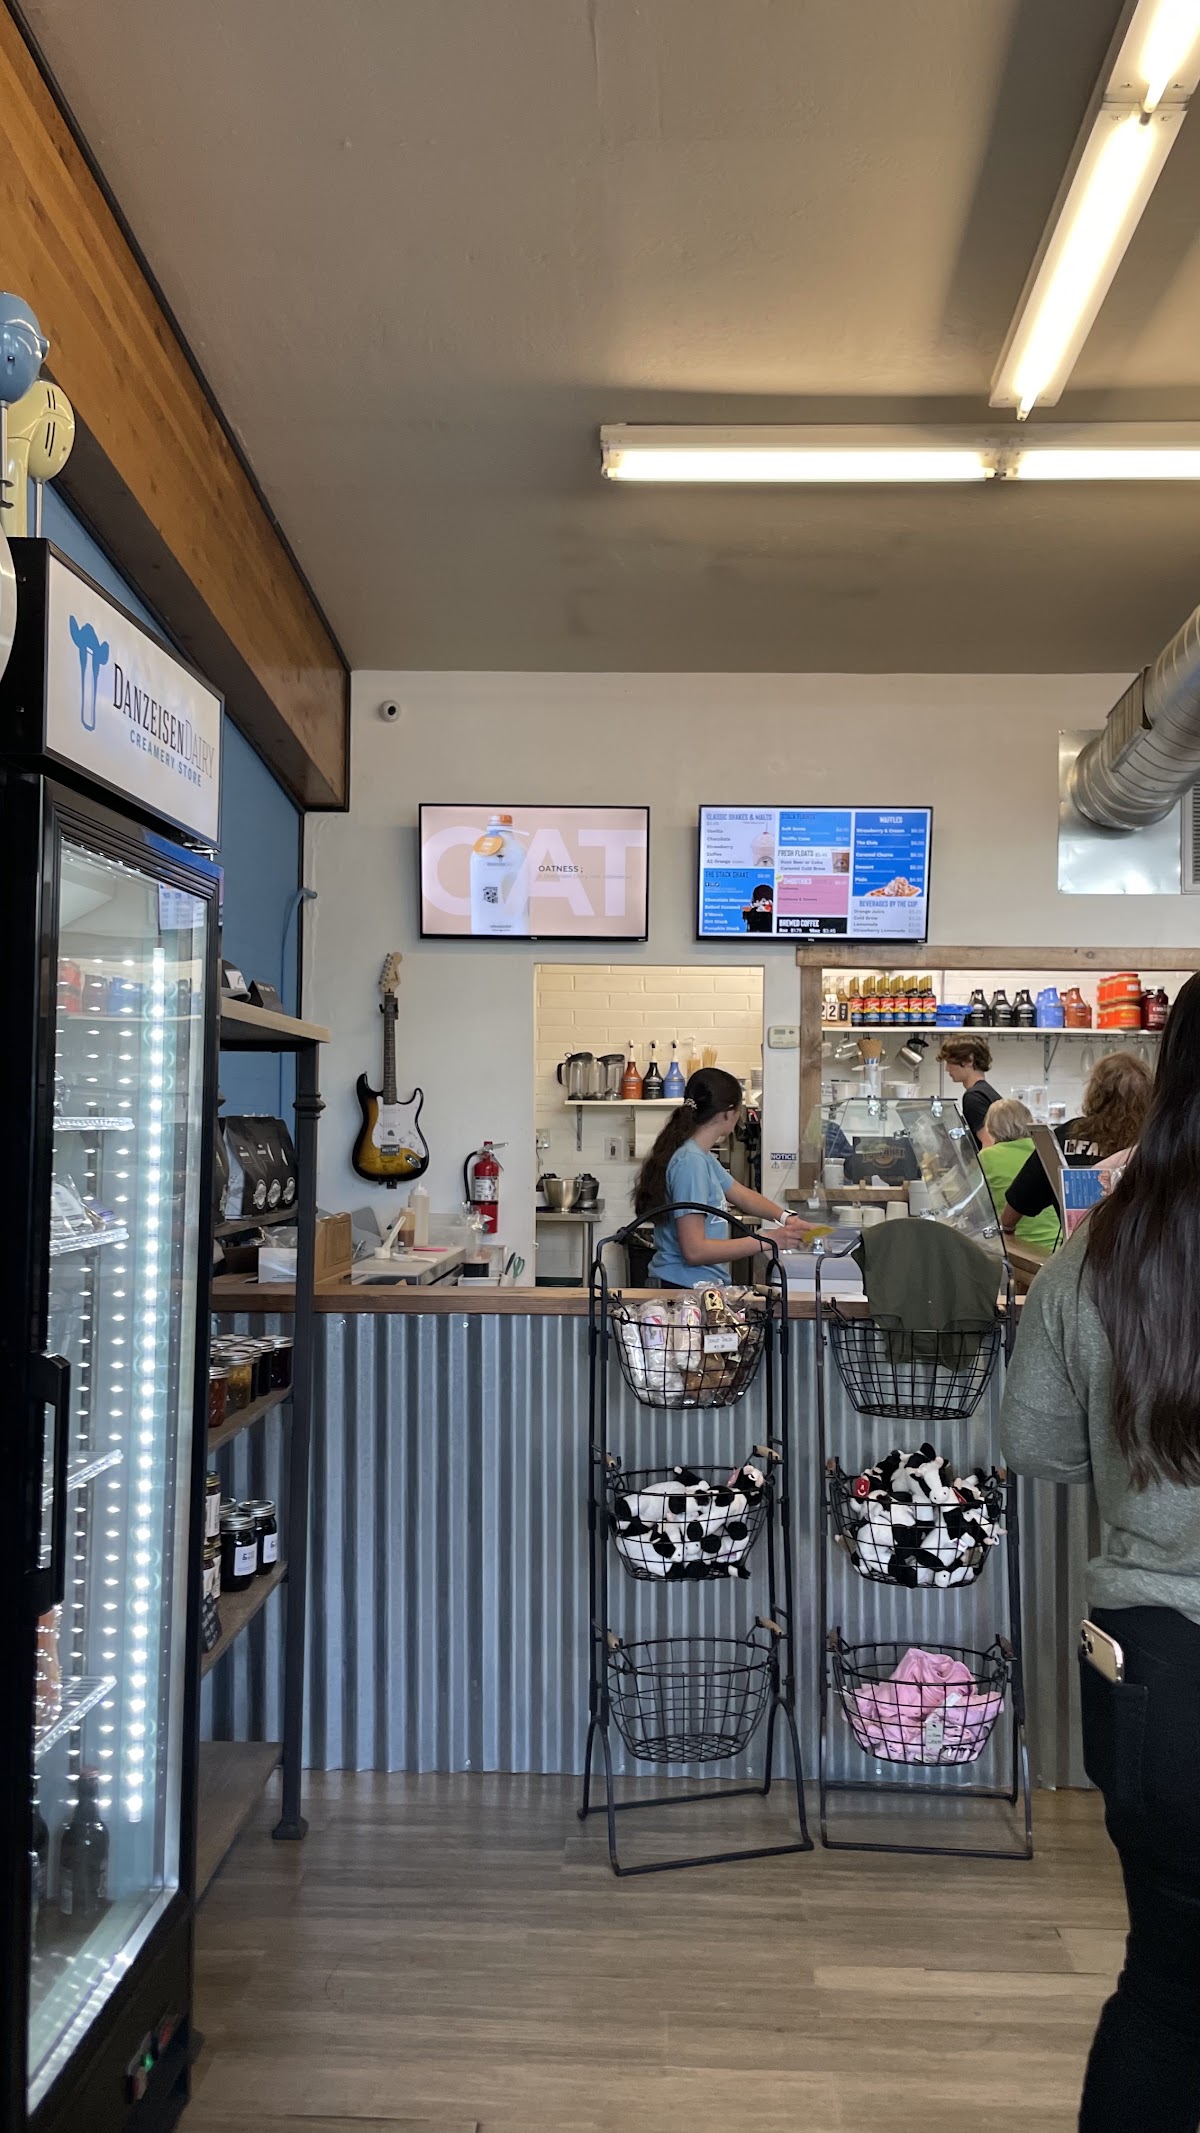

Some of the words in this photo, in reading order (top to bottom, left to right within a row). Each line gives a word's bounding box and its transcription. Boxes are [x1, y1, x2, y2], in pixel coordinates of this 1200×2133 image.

[129, 729, 176, 769] CREAMERY
[178, 761, 202, 788] STORE
[728, 813, 749, 821] SHAKES
[749, 813, 755, 821] &
[755, 813, 773, 821] MALTS
[879, 816, 903, 824] WAFFLES
[779, 849, 794, 857] FRESH
[795, 849, 814, 857] FLOATS
[538, 865, 580, 873] OATNESS
[732, 871, 750, 879] SHAKE
[859, 900, 889, 908] BEVERAGES
[889, 900, 896, 908] BY
[897, 900, 907, 908] THE
[908, 900, 918, 908] CUP
[779, 919, 800, 927] BREWED
[800, 919, 820, 928] COFFEE
